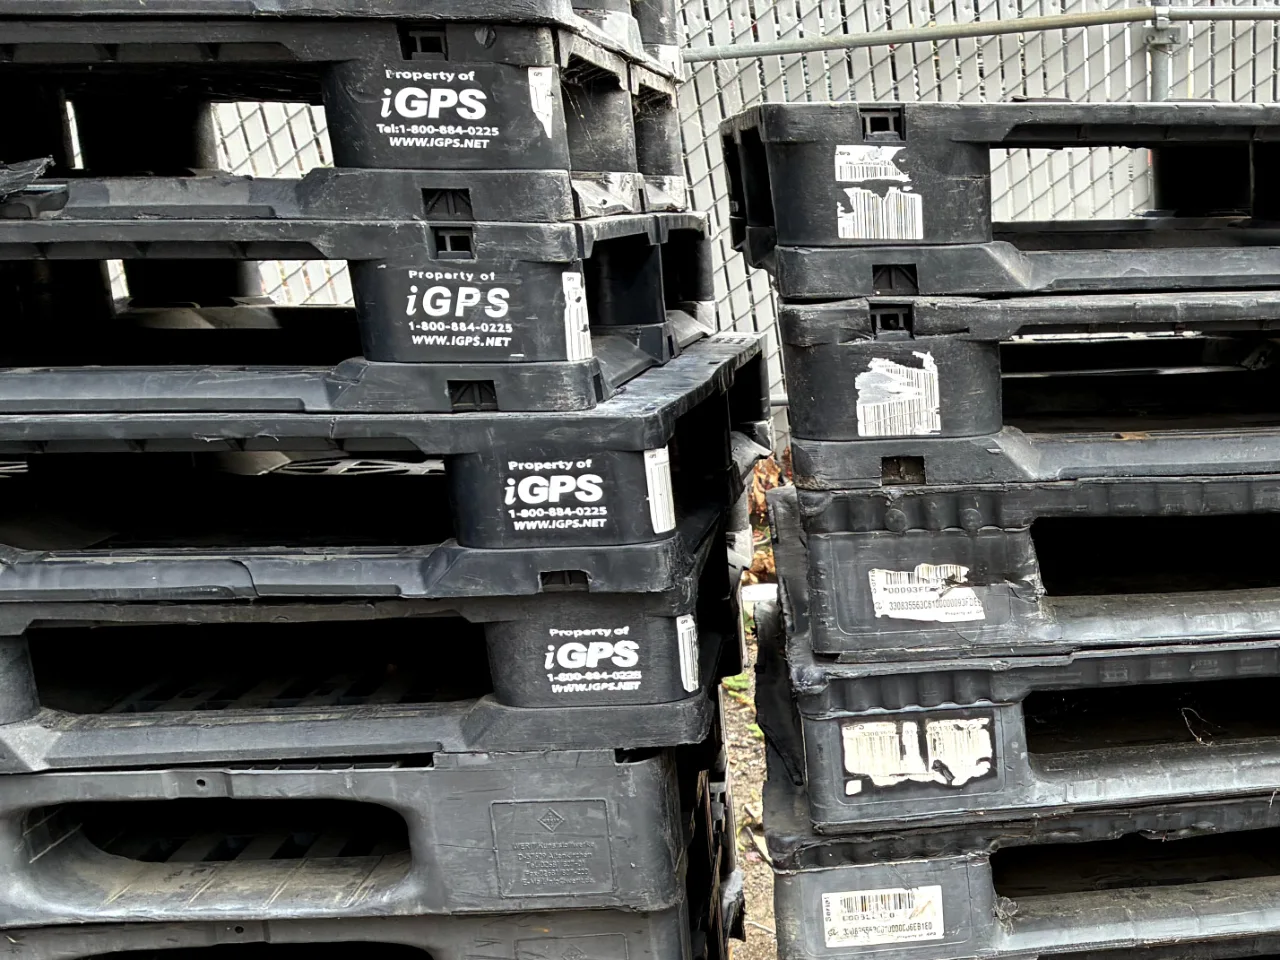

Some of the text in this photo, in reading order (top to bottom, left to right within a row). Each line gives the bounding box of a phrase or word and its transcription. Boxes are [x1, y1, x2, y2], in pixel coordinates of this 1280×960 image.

[385, 69, 475, 82] Property of
[380, 86, 488, 120] iGPS
[376, 124, 500, 136] Tel:1-800-884-0225
[389, 137, 490, 149] WWW.IGPS.NET
[408, 270, 495, 282] Property of
[405, 285, 510, 318] iGPS
[408, 321, 513, 333] 1-800-884-0225
[412, 335, 512, 347] WWW.IGPS.NET
[508, 458, 593, 471] Property of
[504, 474, 603, 505] iGPS
[508, 506, 608, 518] 1-800-884-0225
[513, 518, 607, 531] WWW.IGPS.NET
[549, 626, 630, 638] Property of
[544, 640, 640, 669] iGPS
